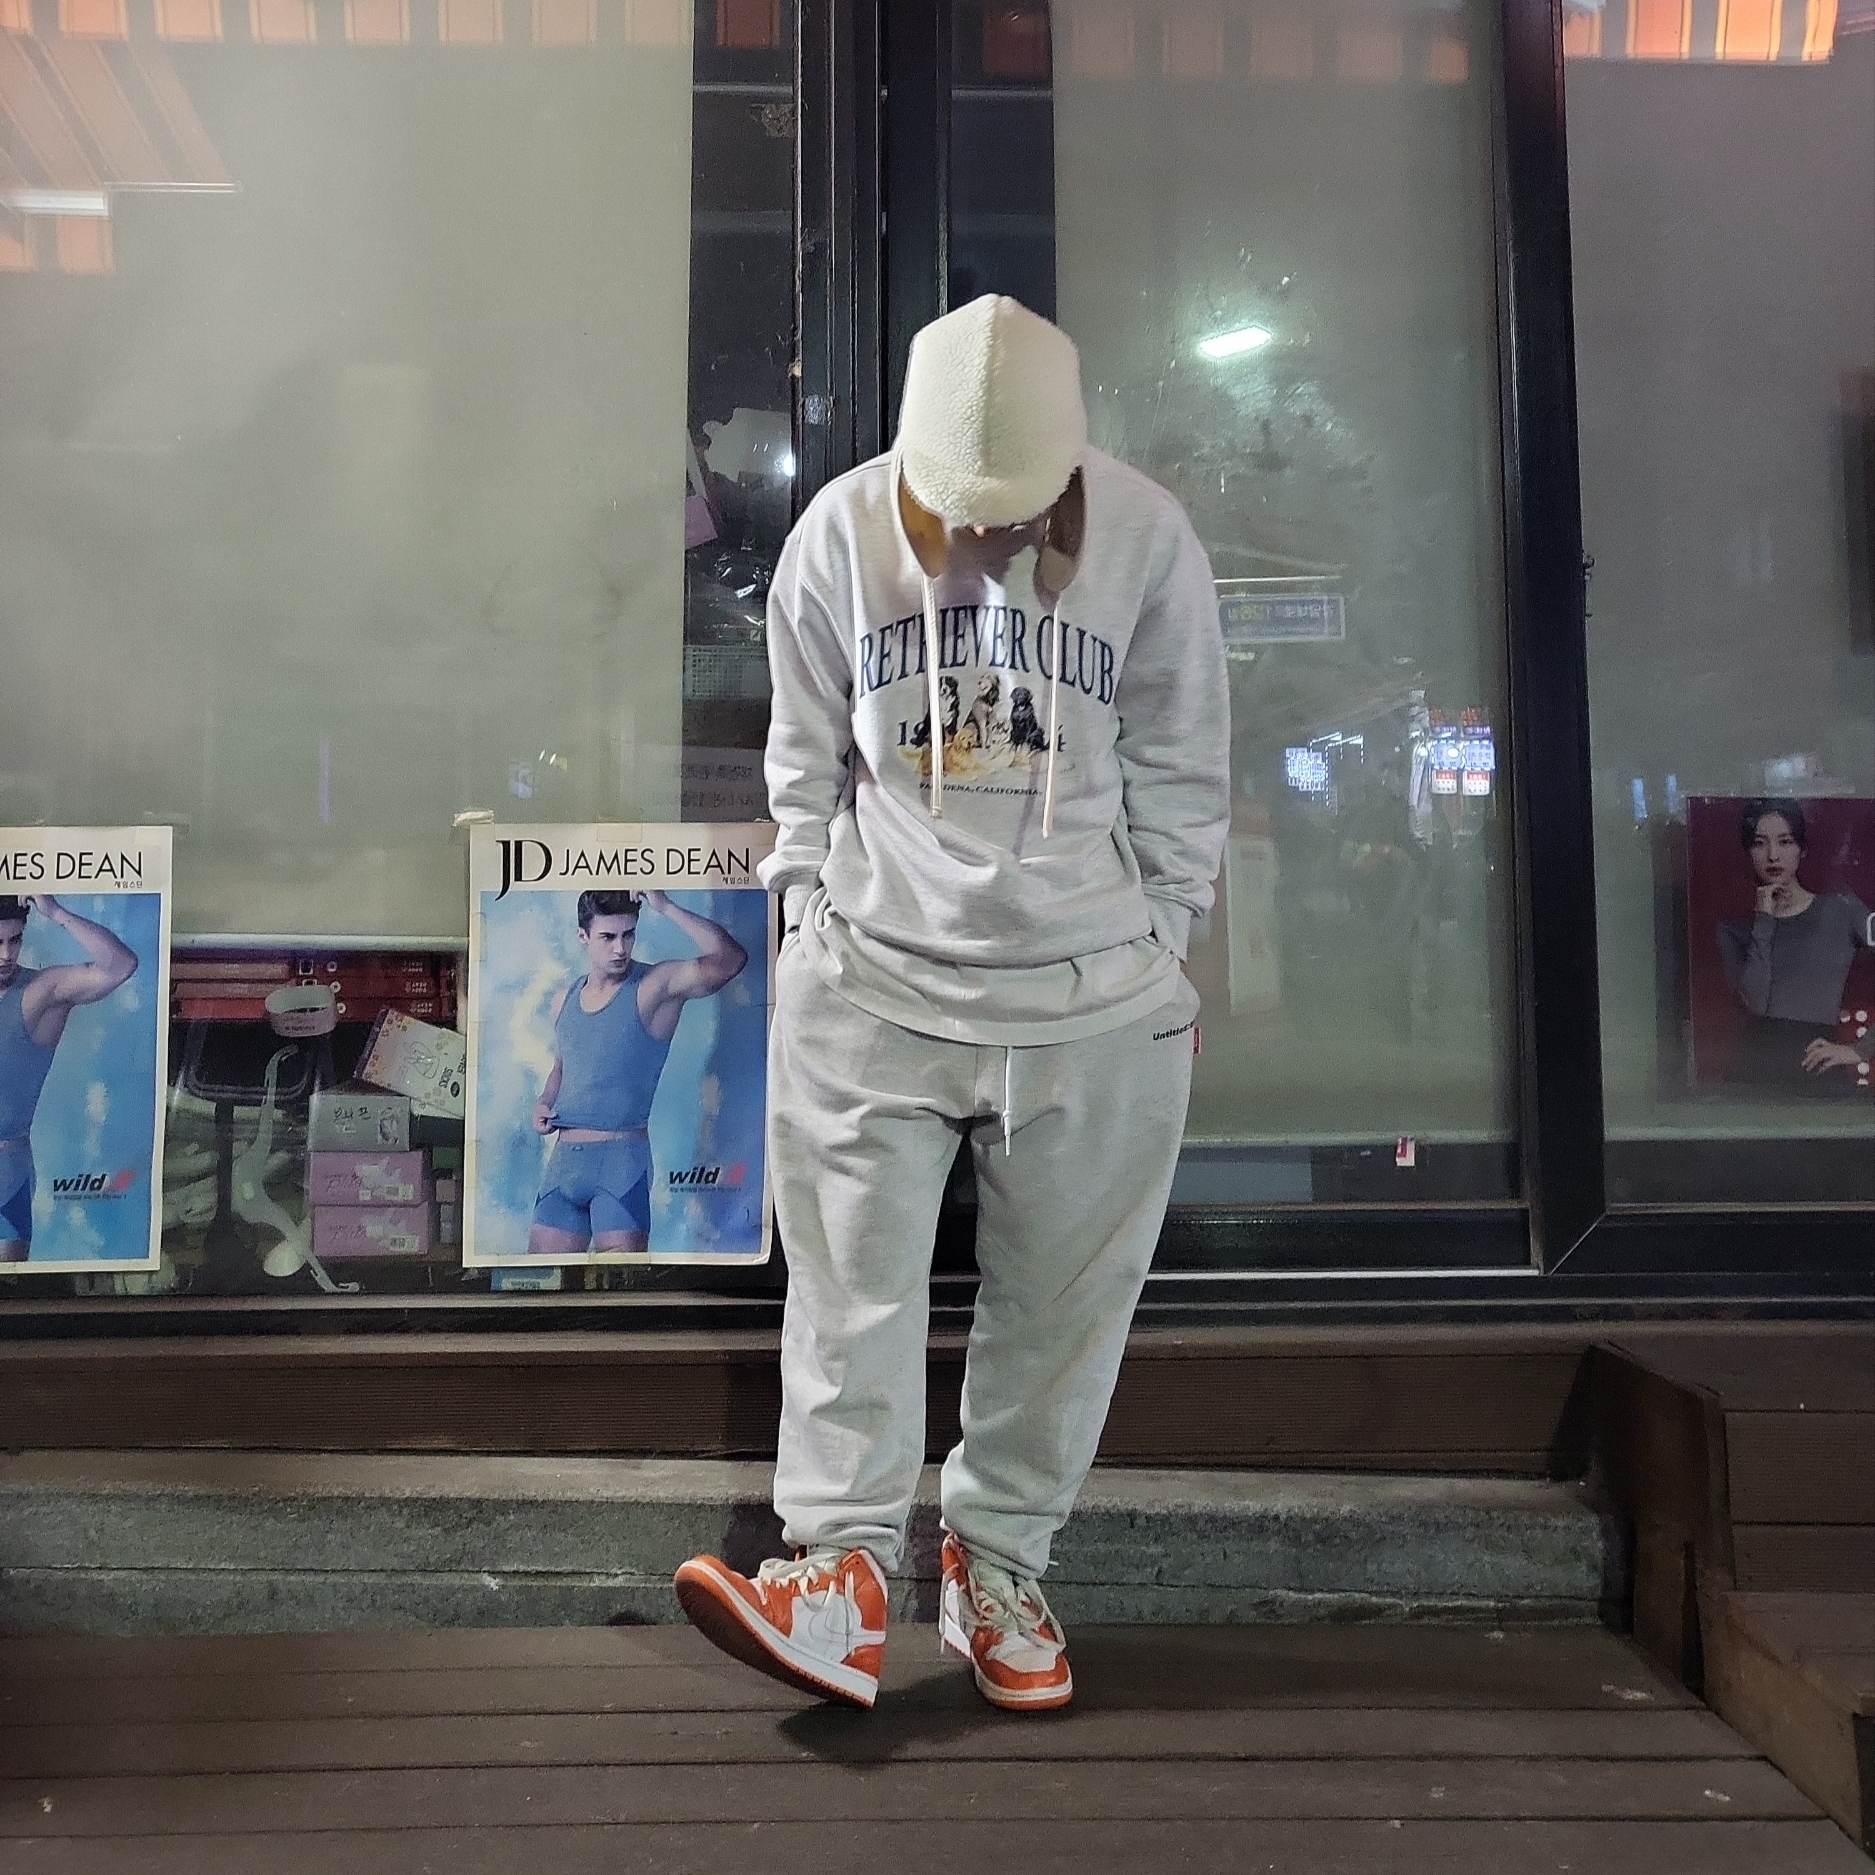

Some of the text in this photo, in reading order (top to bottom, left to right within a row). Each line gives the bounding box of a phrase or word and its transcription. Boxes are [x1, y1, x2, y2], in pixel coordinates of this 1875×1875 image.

[56, 851, 142, 880] DEAN
[495, 840, 750, 902] JD JAMES DEAN
[53, 1173, 107, 1192] wild
[669, 1166, 720, 1184] wild
